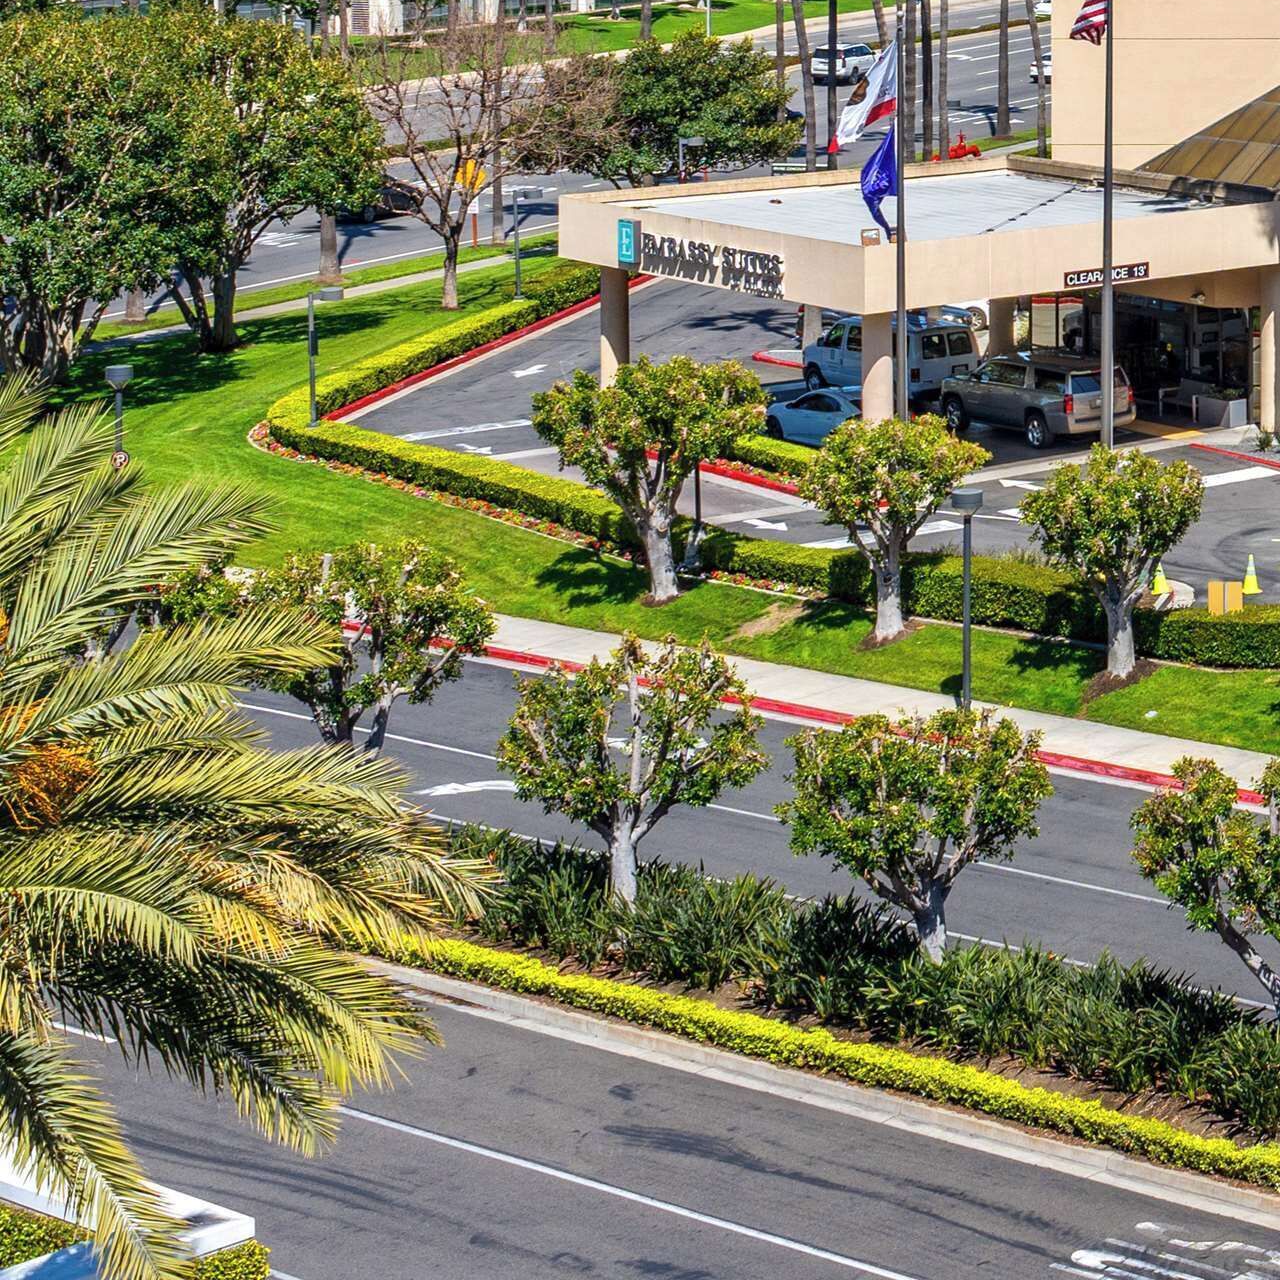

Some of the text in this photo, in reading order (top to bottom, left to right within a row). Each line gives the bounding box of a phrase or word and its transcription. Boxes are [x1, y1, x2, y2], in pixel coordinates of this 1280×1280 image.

[641, 232, 721, 268] EMBASSY
[1066, 265, 1147, 286] CLEARCE 13'
